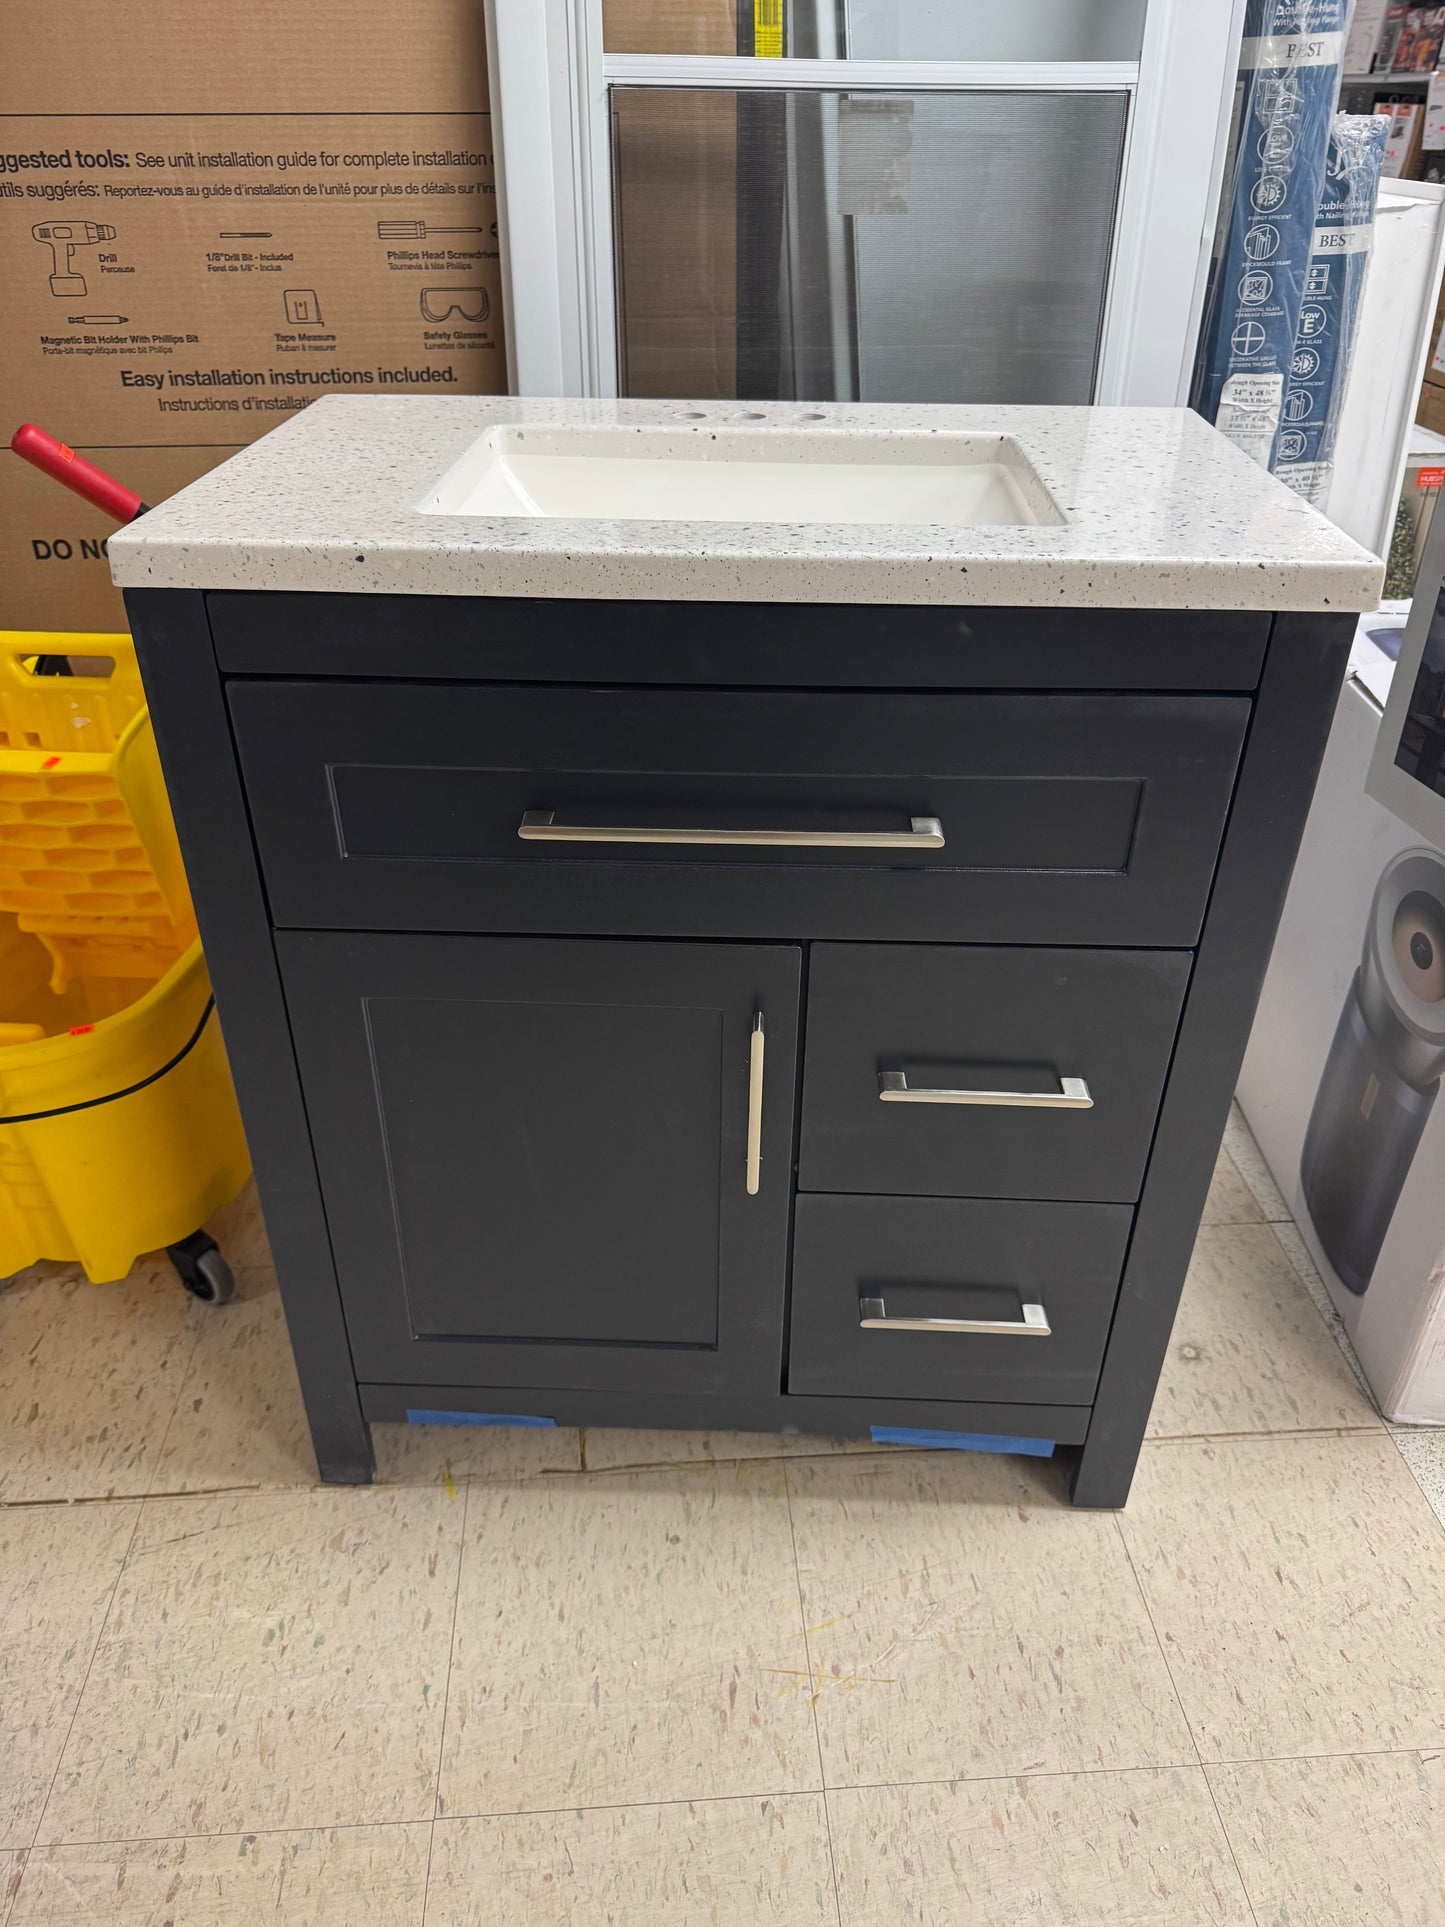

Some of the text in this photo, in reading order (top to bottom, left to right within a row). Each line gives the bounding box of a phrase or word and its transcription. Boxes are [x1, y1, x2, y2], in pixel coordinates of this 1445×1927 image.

[75, 149, 130, 168] tools:
[135, 152, 165, 168] See
[168, 152, 196, 168] unit
[199, 151, 273, 168] installation
[277, 151, 317, 170] guide
[319, 151, 339, 167] for
[343, 150, 409, 170] complete
[412, 150, 487, 167] installation
[26, 180, 100, 201] suggérés:
[104, 184, 184, 199] Reportez-vous
[186, 186, 200, 197] au
[202, 184, 232, 199] guide
[233, 183, 300, 196] d'installation
[302, 183, 317, 195] de
[319, 183, 350, 195] l'unité
[353, 186, 378, 198] pour
[380, 184, 403, 197] plus
[405, 183, 419, 195] de
[421, 182, 456, 195] détails
[457, 184, 475, 194] sur
[98, 253, 118, 263] Drill
[241, 253, 253, 261] Bit
[260, 253, 294, 261] Included
[387, 251, 420, 260] Phillips
[421, 251, 445, 260] Head
[1303, 319, 1315, 333] E
[40, 336, 82, 346] Magnetic
[84, 336, 97, 344] Bit
[99, 335, 128, 344] Holder
[129, 335, 150, 344] With
[186, 335, 199, 344] Bit
[298, 333, 336, 341] Measure
[423, 331, 488, 341] Safety Glasses
[120, 366, 458, 390] Easy installation instructions included.
[158, 396, 318, 412] Instructions d'installati
[32, 539, 73, 560] DO
